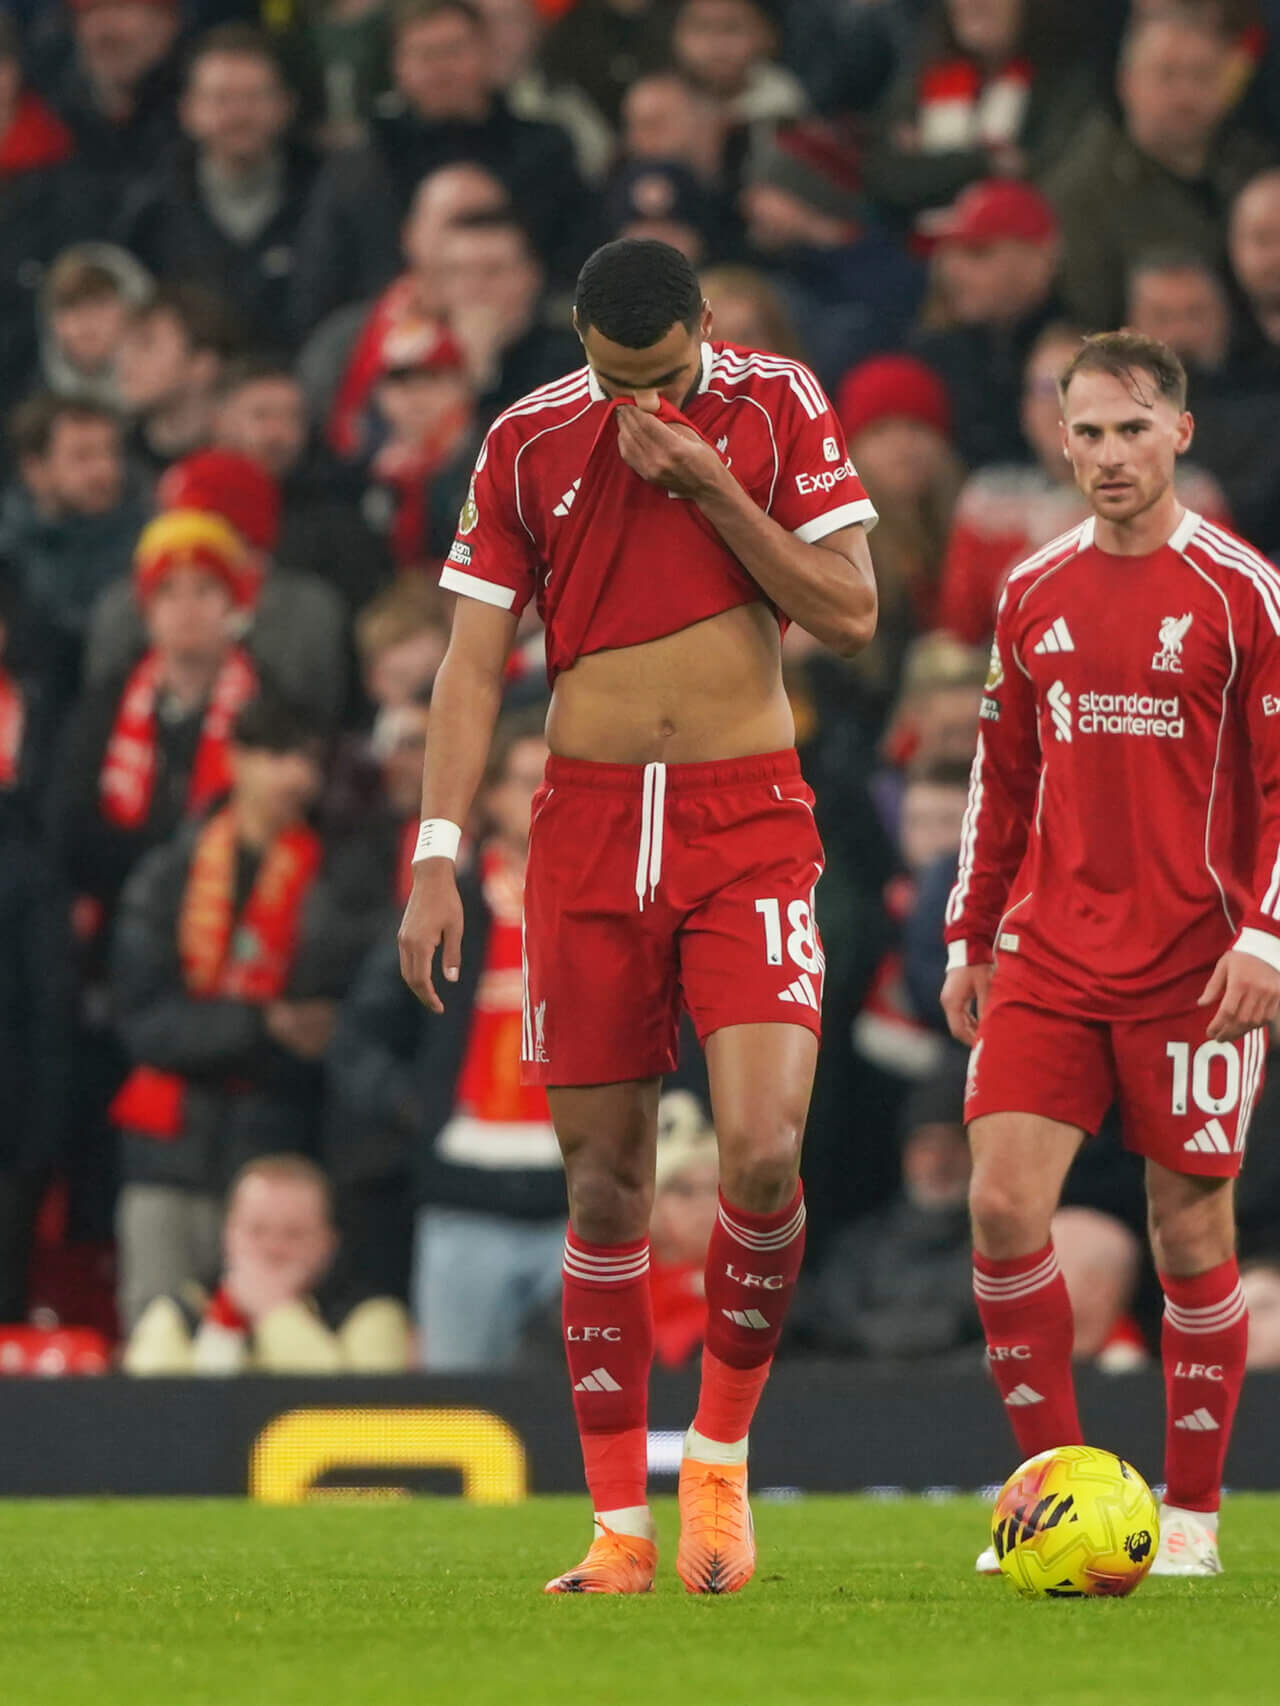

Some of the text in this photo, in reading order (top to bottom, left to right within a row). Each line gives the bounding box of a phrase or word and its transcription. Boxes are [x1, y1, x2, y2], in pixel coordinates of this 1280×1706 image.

[1078, 690, 1179, 717] standard
[1078, 711, 1184, 738] chartered
[755, 898, 820, 974] 18
[1166, 1039, 1241, 1116] 10
[725, 1263, 784, 1290] LFC
[567, 1326, 621, 1341] LFC
[1175, 1362, 1224, 1380] LFC
